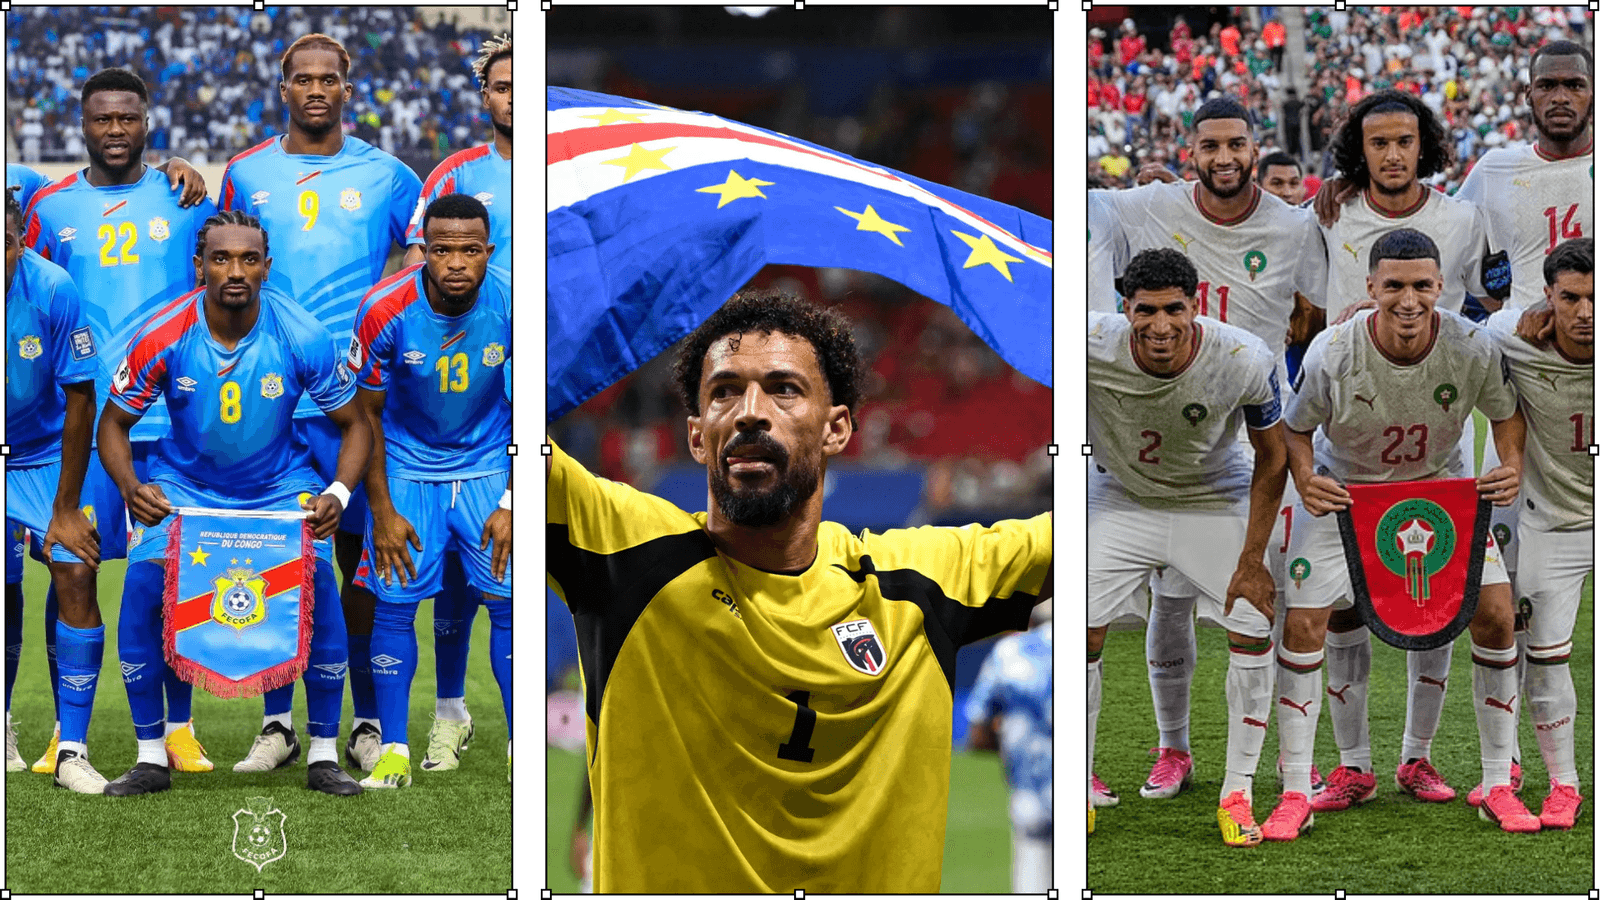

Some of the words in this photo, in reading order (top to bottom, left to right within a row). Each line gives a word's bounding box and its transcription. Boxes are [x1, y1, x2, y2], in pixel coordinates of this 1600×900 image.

[298, 189, 320, 231] 9
[1543, 202, 1583, 256] 14
[97, 221, 140, 267] 22
[1197, 281, 1230, 323] 11
[435, 352, 470, 393] 13
[219, 380, 242, 424] 8
[1138, 429, 1163, 465] 2
[1381, 424, 1429, 465] 23
[1569, 413, 1593, 452] 1
[200, 531, 238, 539] REPUBLIQUE
[239, 533, 287, 541] DEMOCRATIQUE
[221, 540, 233, 548] DU
[234, 540, 262, 549] CONGO
[221, 612, 257, 624] FECOFA
[835, 621, 868, 636] FCF
[777, 690, 817, 763] 1
